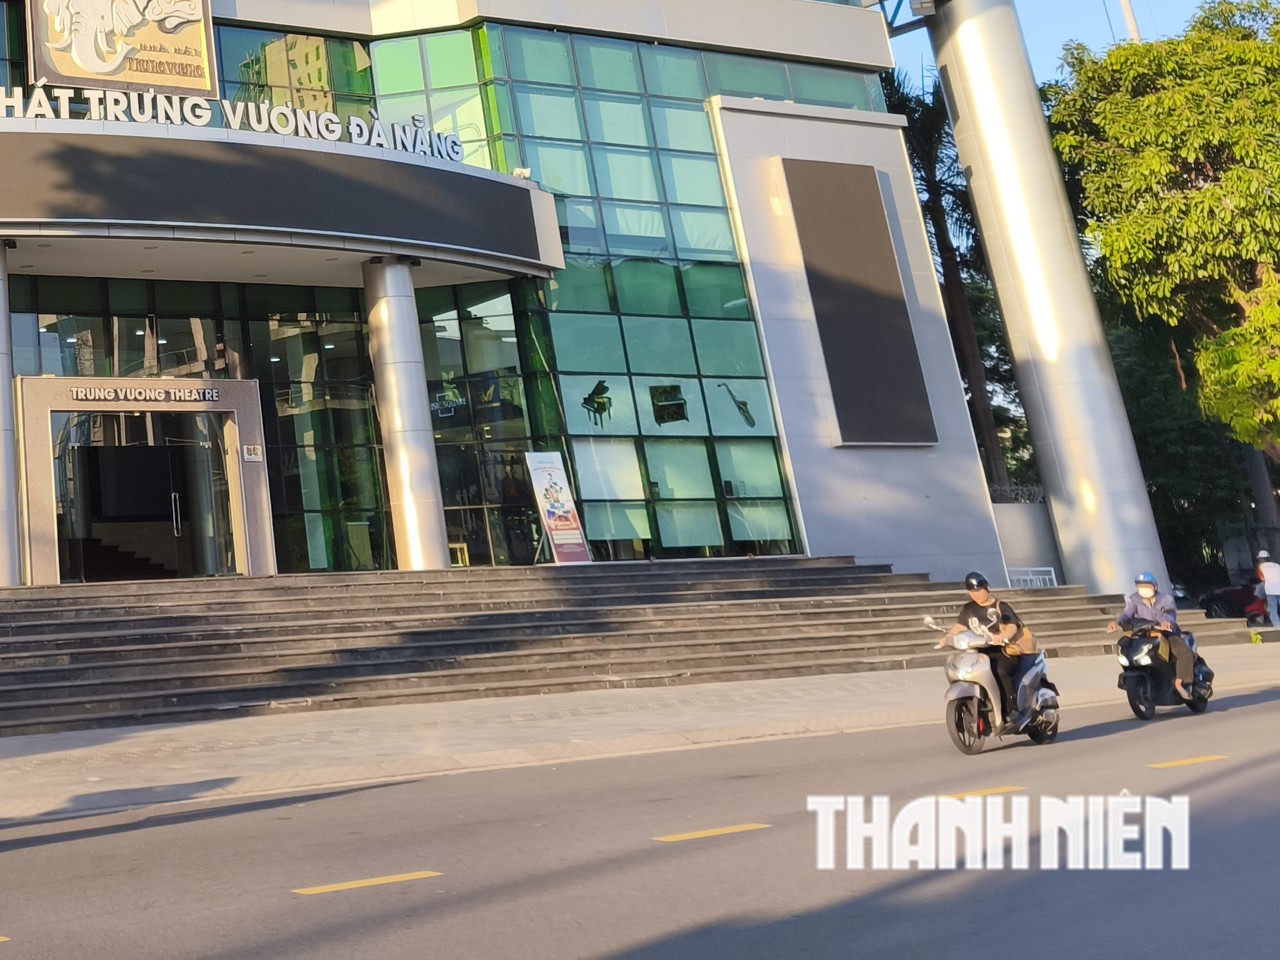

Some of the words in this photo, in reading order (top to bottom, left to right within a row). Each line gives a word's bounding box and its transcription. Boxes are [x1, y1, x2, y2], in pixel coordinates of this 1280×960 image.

[83, 87, 212, 127] TRƯNG
[221, 98, 342, 141] VƯƠNG
[346, 107, 390, 149] ĐÀ
[71, 387, 116, 401] TRUNG
[115, 387, 166, 401] VUONG
[169, 388, 219, 401] THEATRE
